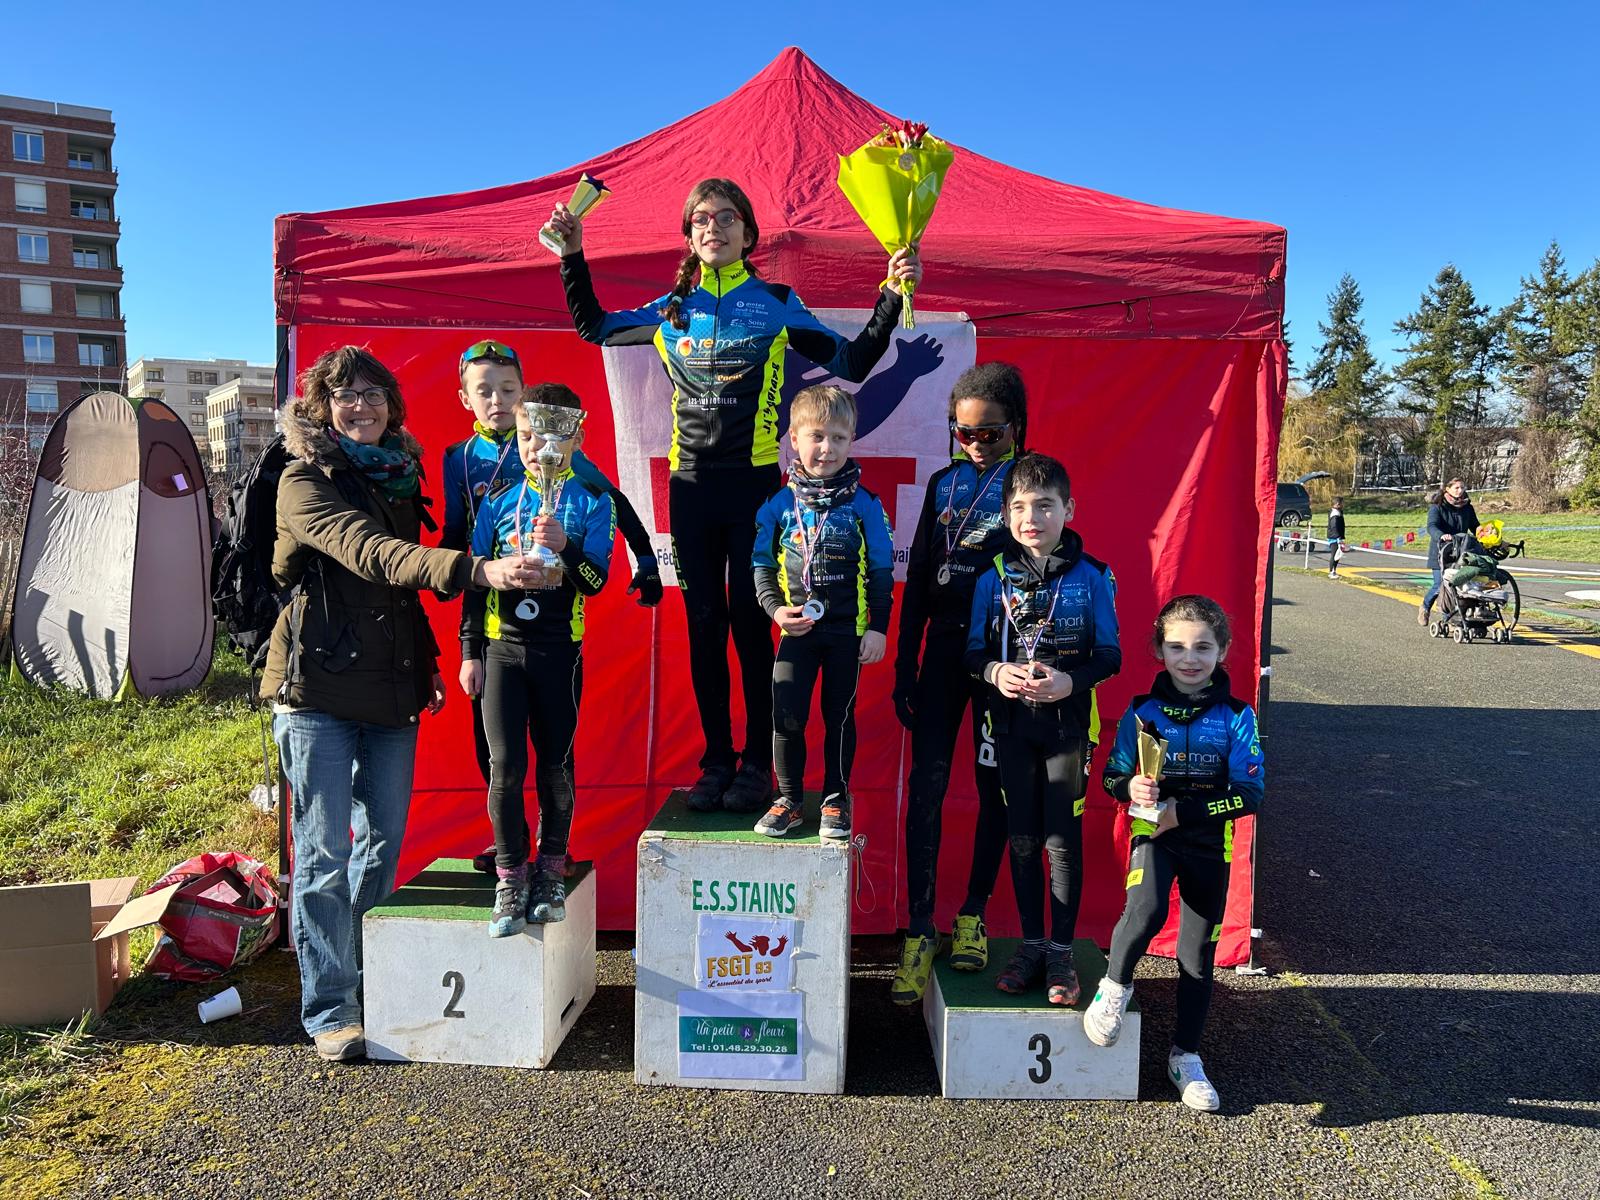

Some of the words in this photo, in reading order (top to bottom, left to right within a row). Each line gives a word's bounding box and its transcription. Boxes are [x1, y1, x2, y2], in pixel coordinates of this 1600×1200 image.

[577, 562, 603, 590] ASELB
[1207, 795, 1244, 816] SELB
[692, 880, 796, 914] E.S.STAINS
[706, 954, 753, 979] FSGT
[755, 961, 772, 975] 93
[755, 976, 772, 985] sport
[442, 971, 466, 1019] 2
[711, 1023, 734, 1043] petit
[755, 1020, 785, 1044] fleuri
[713, 1044, 788, 1053] 01.48.29.30.28
[1028, 1034, 1052, 1084] 3
